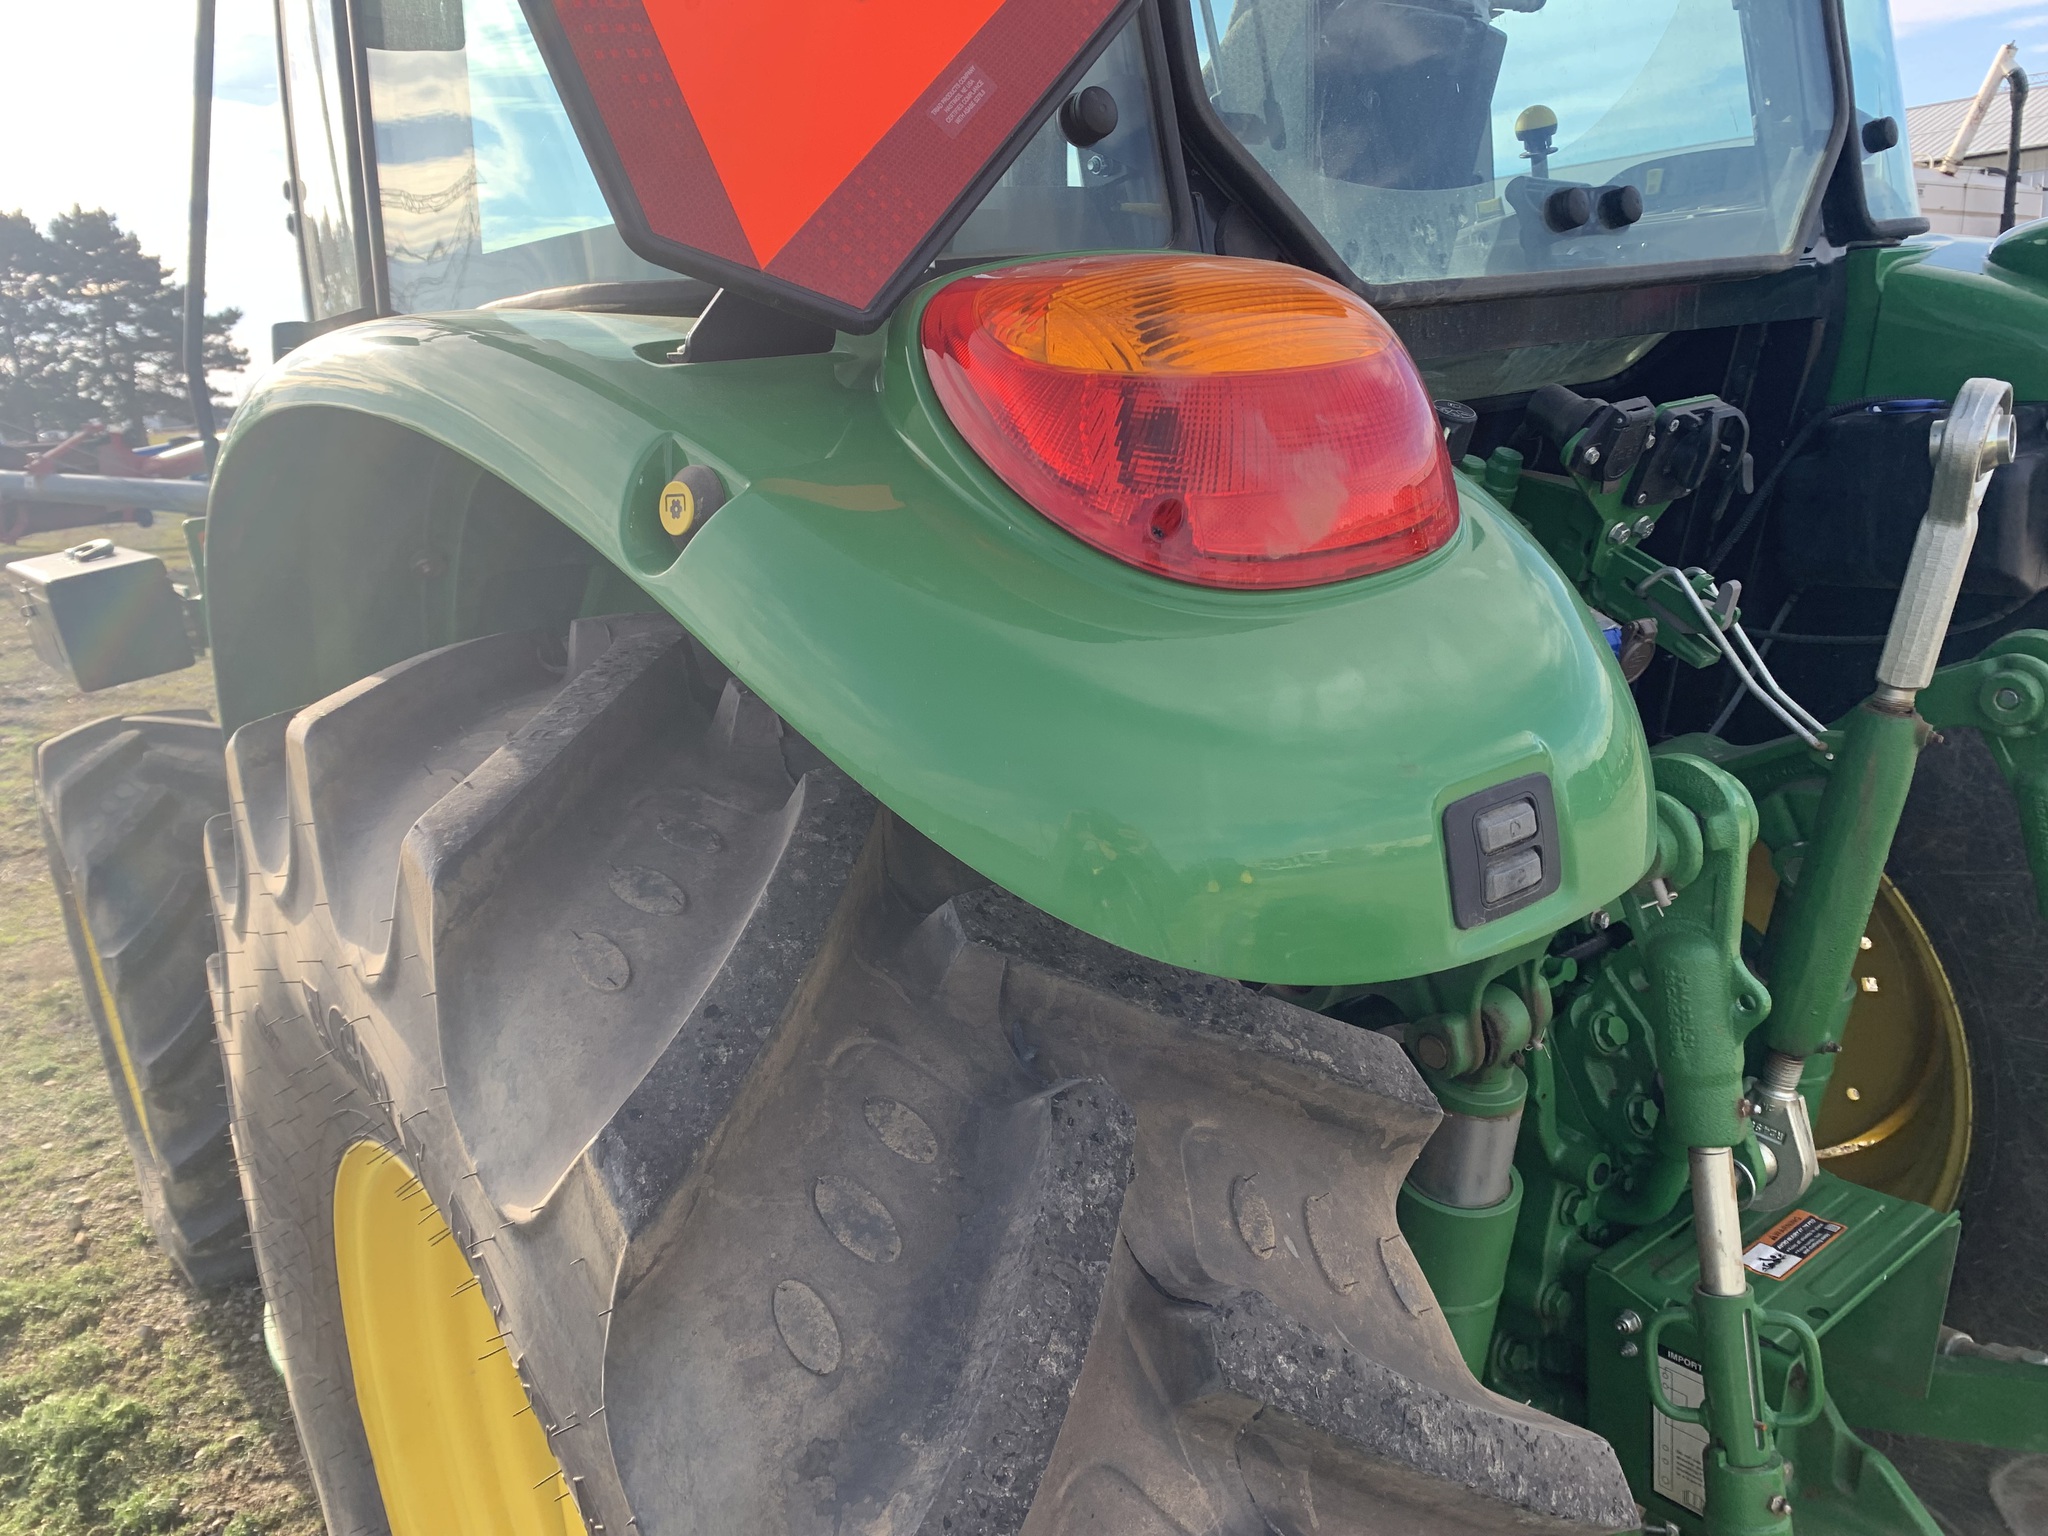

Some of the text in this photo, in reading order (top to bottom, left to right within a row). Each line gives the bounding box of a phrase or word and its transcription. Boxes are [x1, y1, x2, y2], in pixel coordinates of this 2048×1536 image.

[931, 64, 976, 116] TRIAD PRODUCTS COMPANY
[945, 79, 984, 123] CERTIFIES COMPLIANCE
[955, 112, 966, 125] WITH
